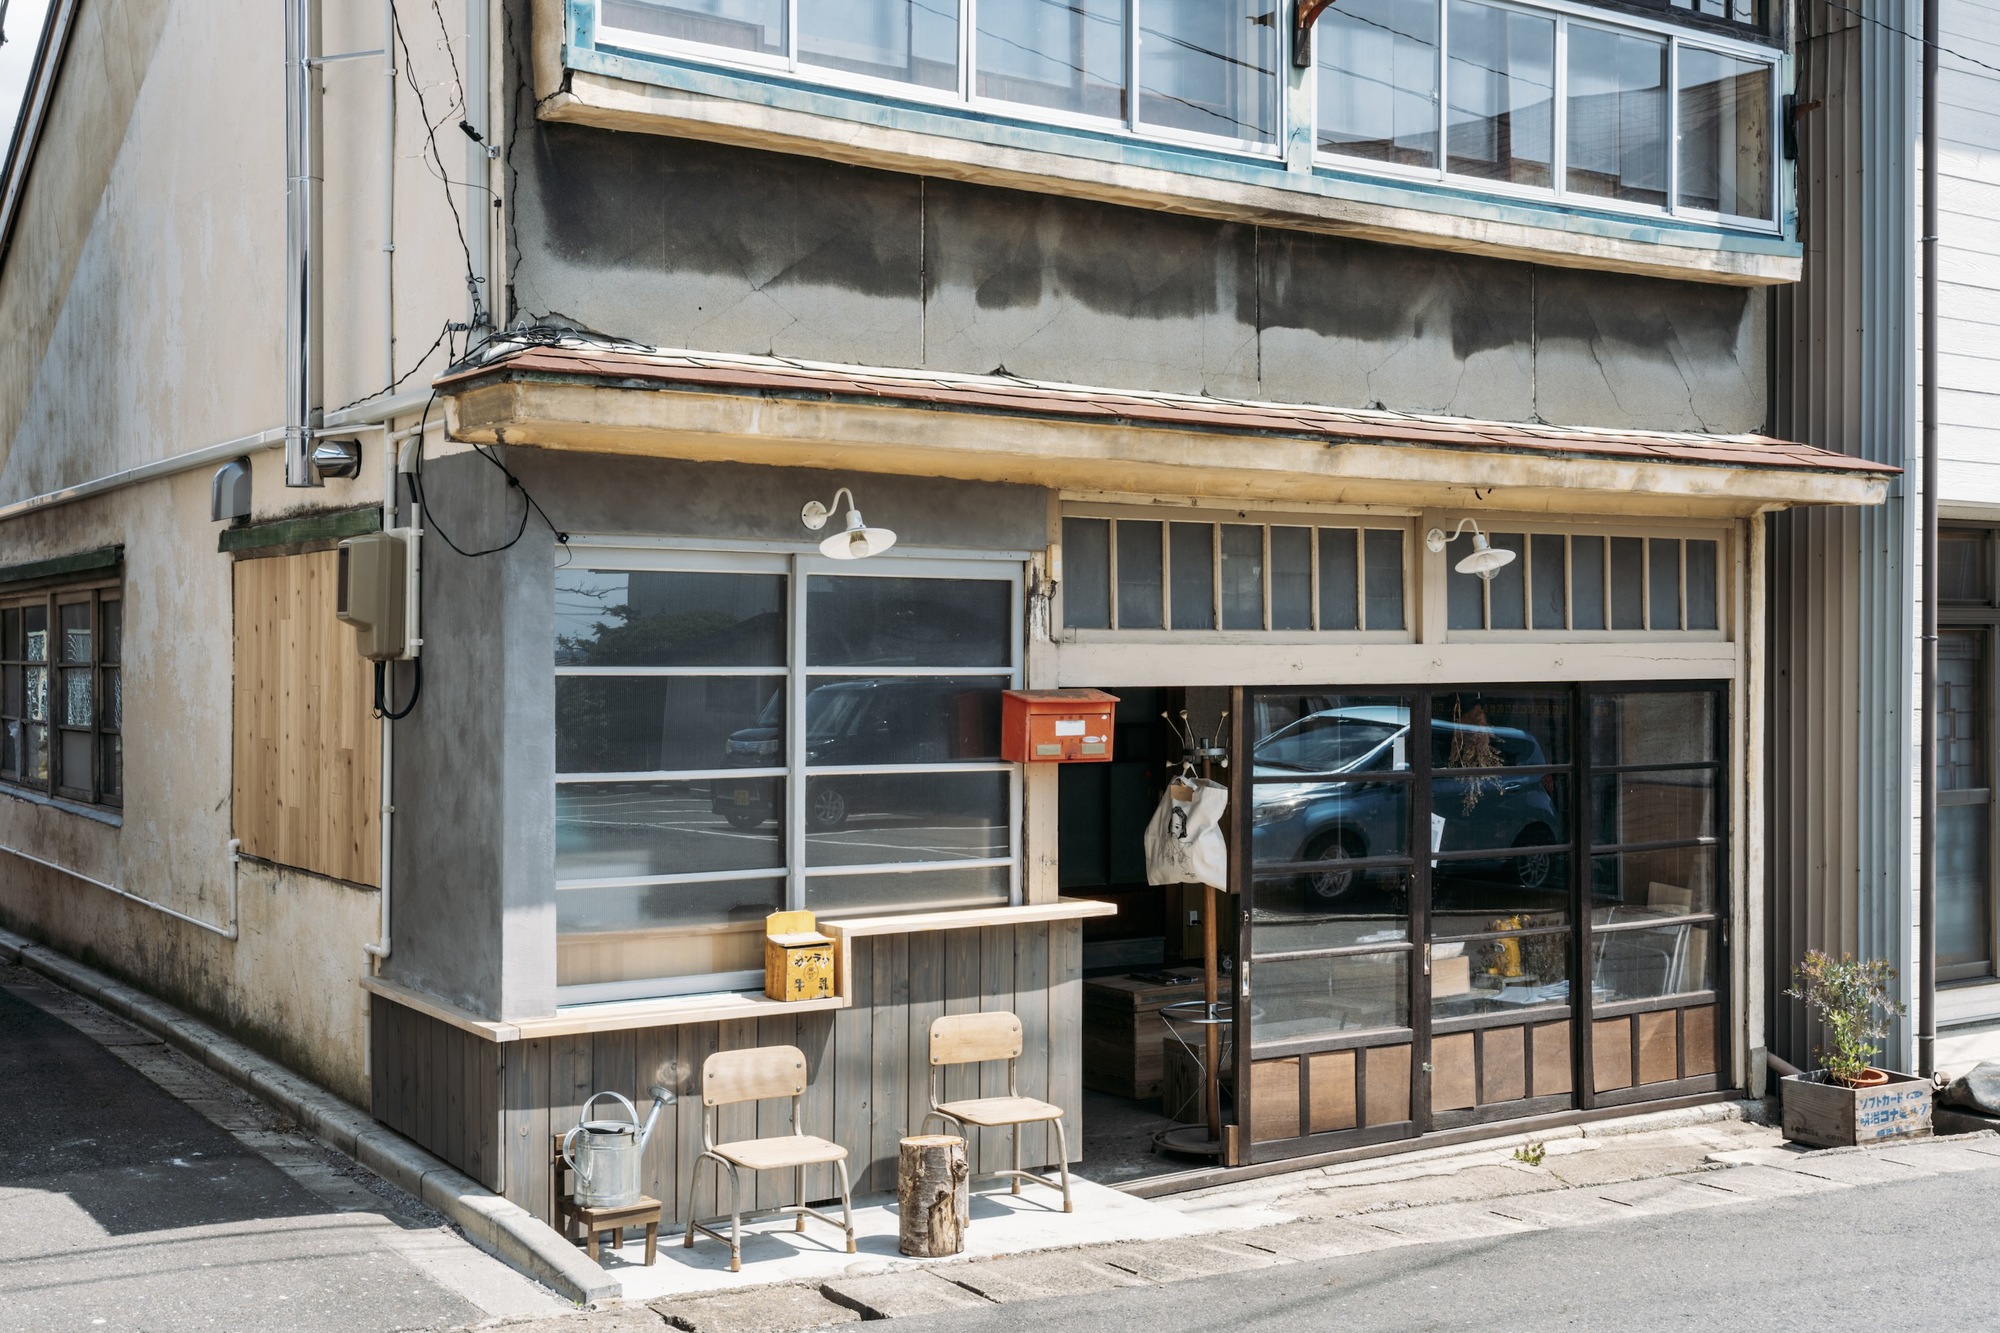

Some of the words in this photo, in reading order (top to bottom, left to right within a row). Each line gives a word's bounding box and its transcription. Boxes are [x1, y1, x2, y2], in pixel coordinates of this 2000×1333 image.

[1860, 1092, 1903, 1110] ソフトカード
